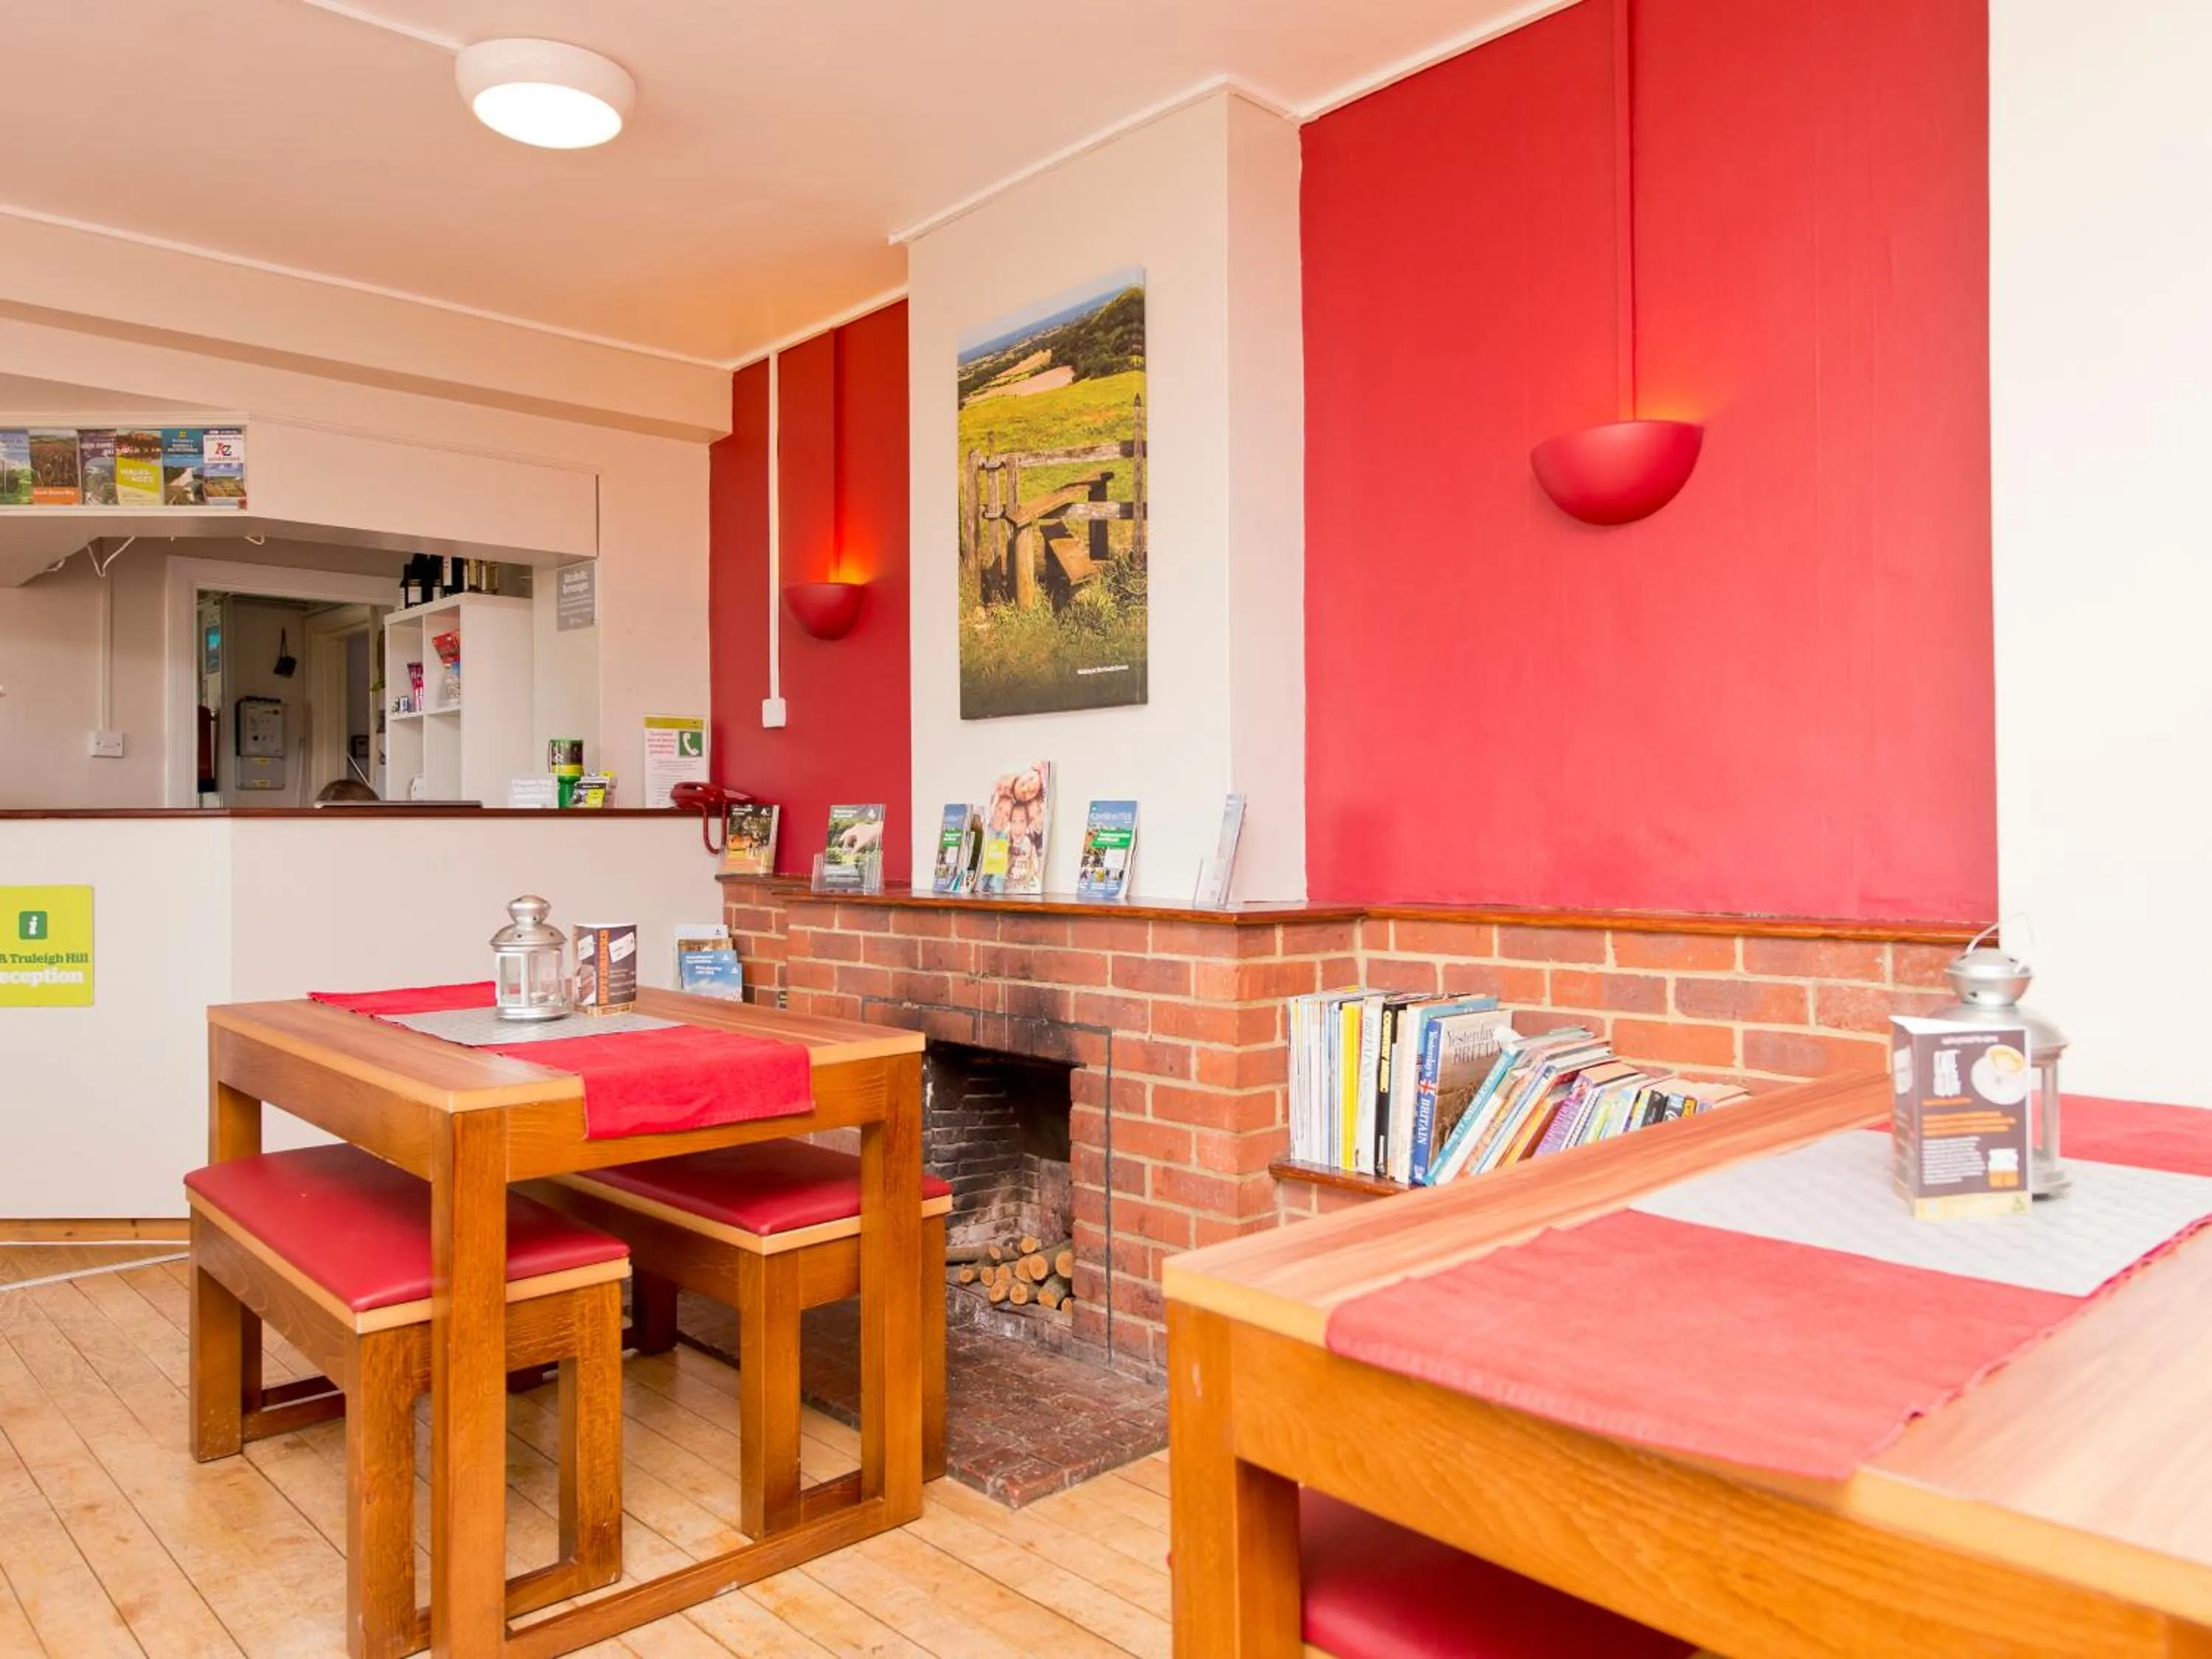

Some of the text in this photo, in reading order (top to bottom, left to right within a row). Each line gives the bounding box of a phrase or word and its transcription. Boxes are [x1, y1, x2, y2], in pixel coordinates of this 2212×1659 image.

[10, 953, 63, 964] Truleigh
[66, 952, 88, 963] Hill
[1423, 1031, 1439, 1077] Yesterday's
[1416, 1099, 1431, 1145] BRITAIN
